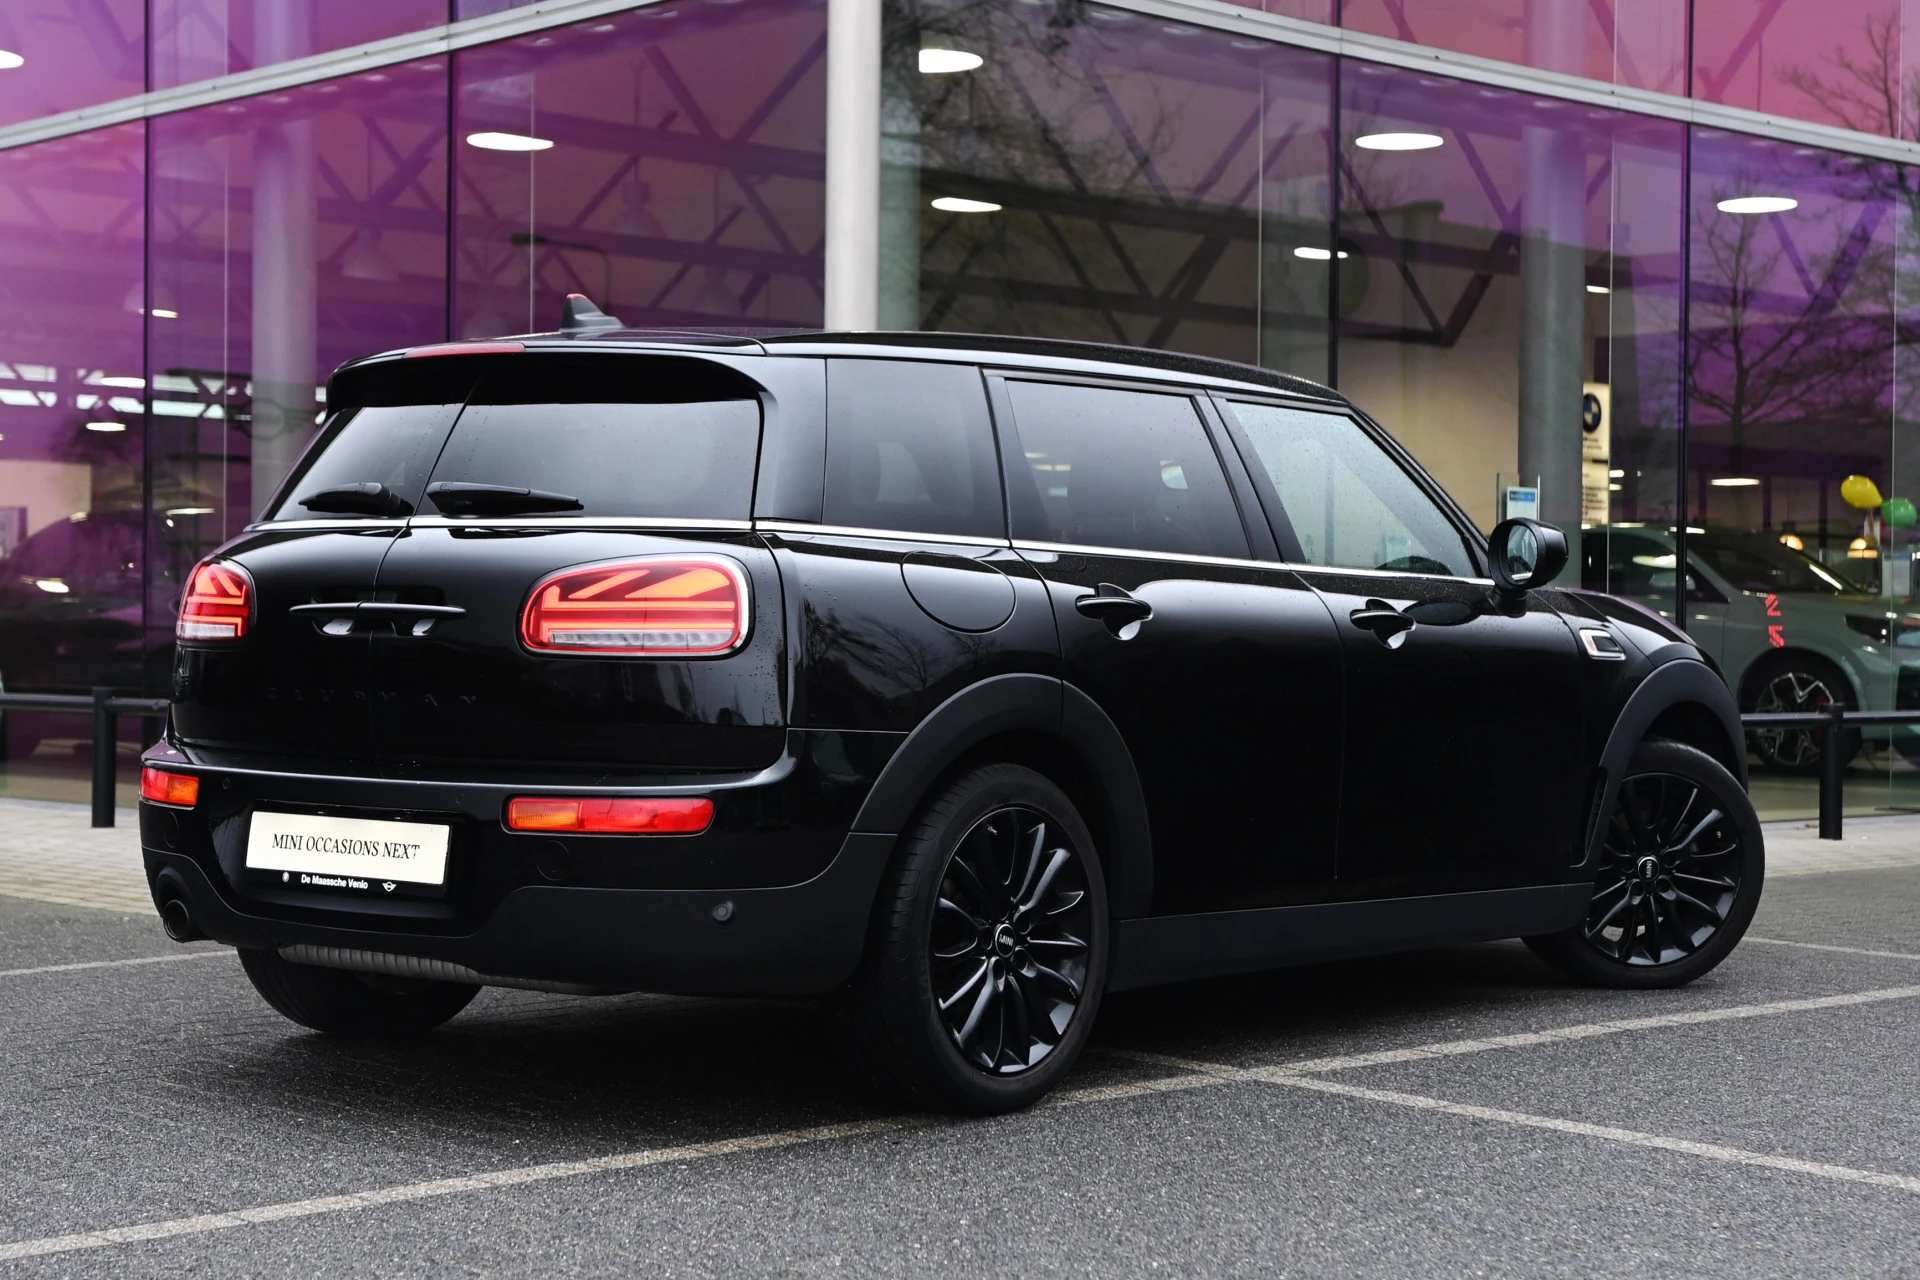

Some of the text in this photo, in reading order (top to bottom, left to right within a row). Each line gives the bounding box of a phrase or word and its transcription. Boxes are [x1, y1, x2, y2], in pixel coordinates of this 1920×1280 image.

[272, 833, 420, 859] MINI OCCASIONS NEXT
[301, 874, 368, 889] De Maassche Venlo
